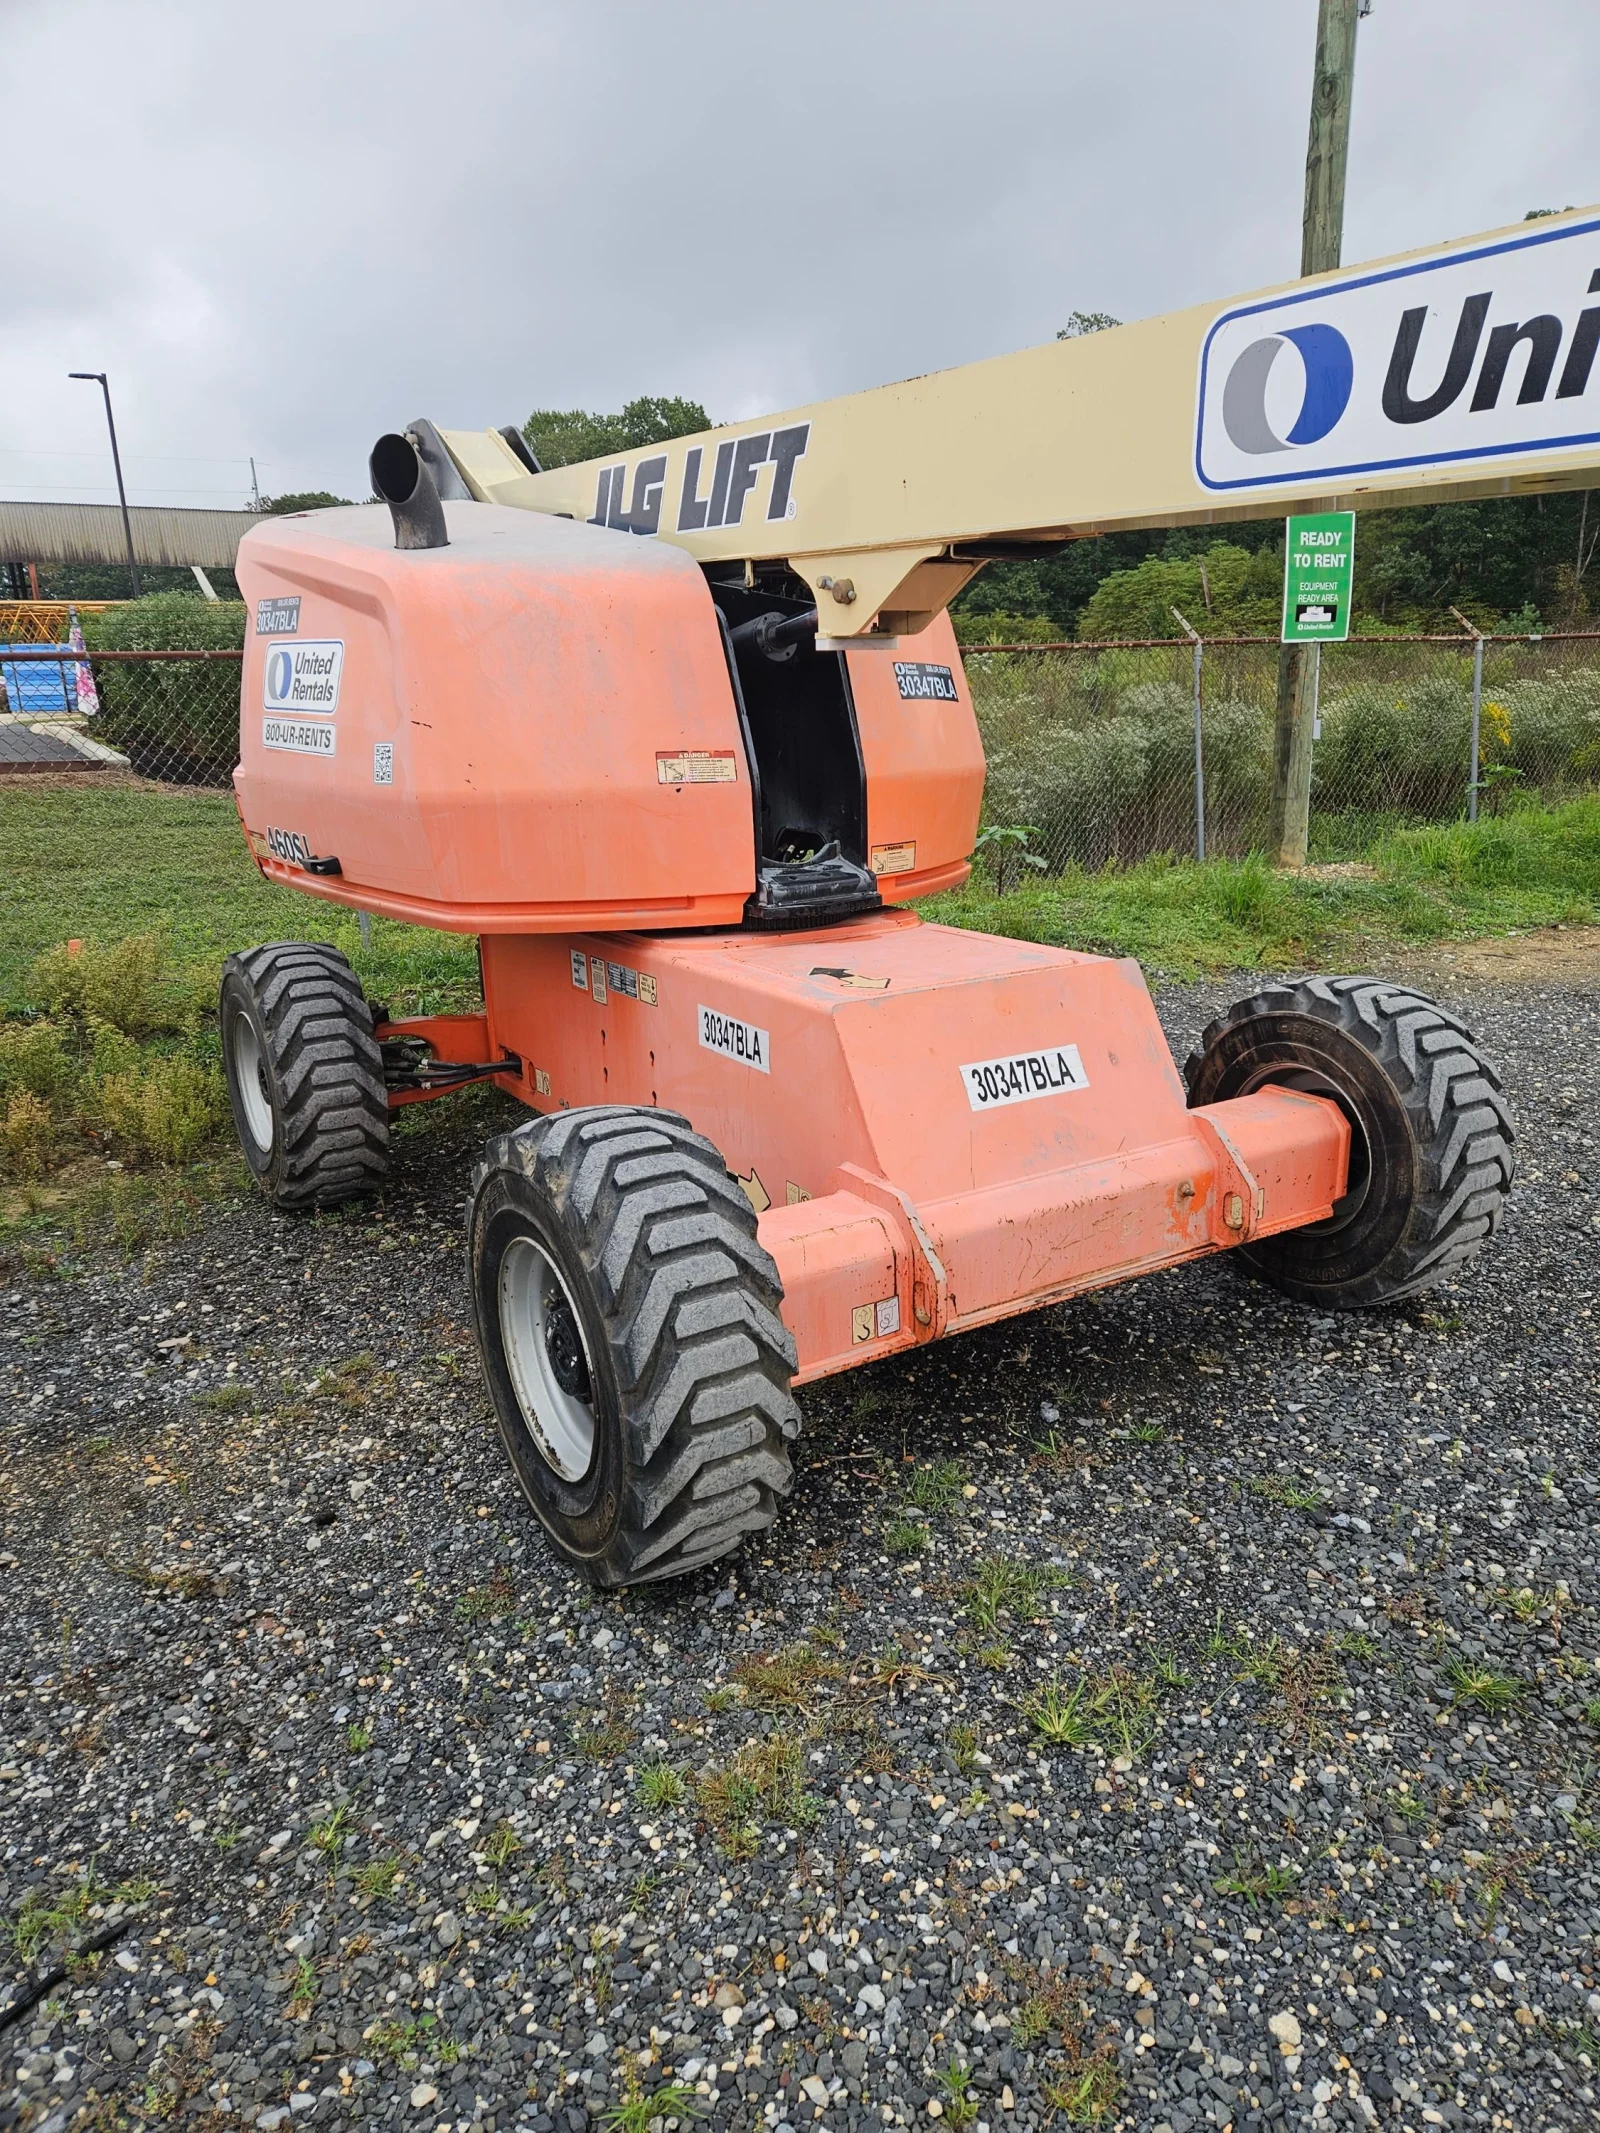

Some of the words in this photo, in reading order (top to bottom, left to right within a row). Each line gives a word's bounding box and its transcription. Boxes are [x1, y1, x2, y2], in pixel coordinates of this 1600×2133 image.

[586, 455, 668, 536] JLG
[677, 424, 810, 531] LIFT
[1300, 532, 1342, 546] READY
[1294, 554, 1311, 567] TO
[1314, 554, 1346, 567] RENT
[1300, 582, 1338, 590] EQUIPMENT
[1298, 594, 1320, 603] READY
[1321, 594, 1338, 602] AREA
[257, 610, 297, 632] 30347BLA
[295, 652, 335, 675] United
[292, 678, 334, 701] Rentals
[898, 676, 957, 699] 30347BLA
[265, 724, 332, 748] 800-UR-RENTS
[704, 1011, 762, 1064] 30347BLA
[971, 1052, 1076, 1102] 30347BLA
